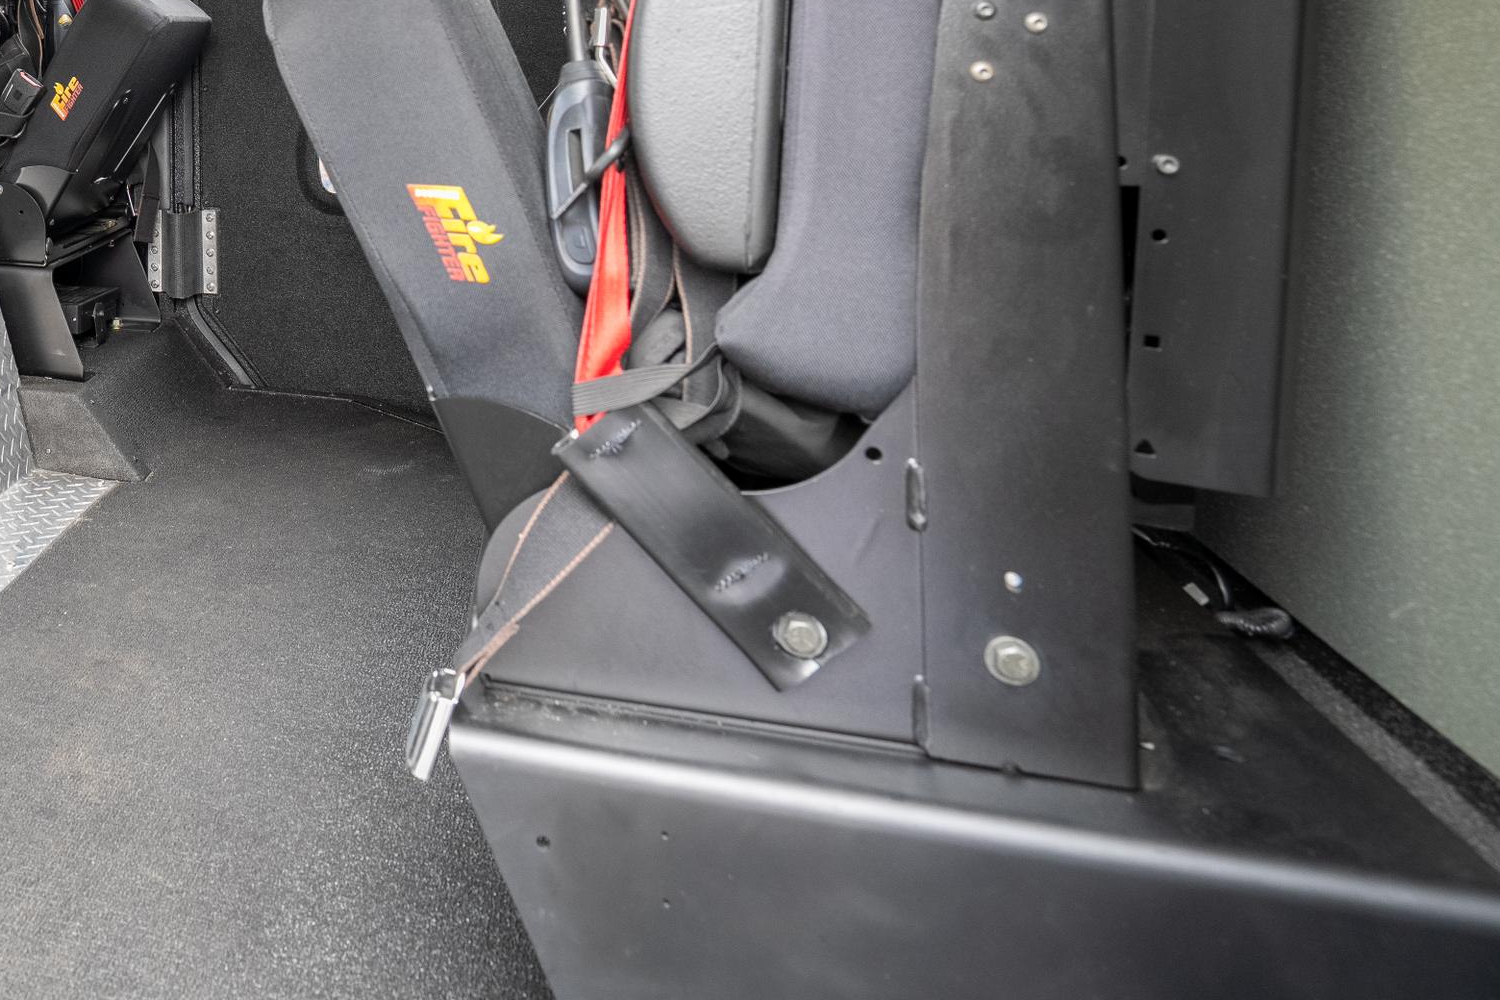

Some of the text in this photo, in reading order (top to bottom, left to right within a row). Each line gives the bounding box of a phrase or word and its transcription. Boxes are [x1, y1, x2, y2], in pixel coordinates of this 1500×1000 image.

[50, 76, 80, 121] Fire
[406, 183, 503, 285] Fire
[418, 205, 467, 282] FIGHTER
